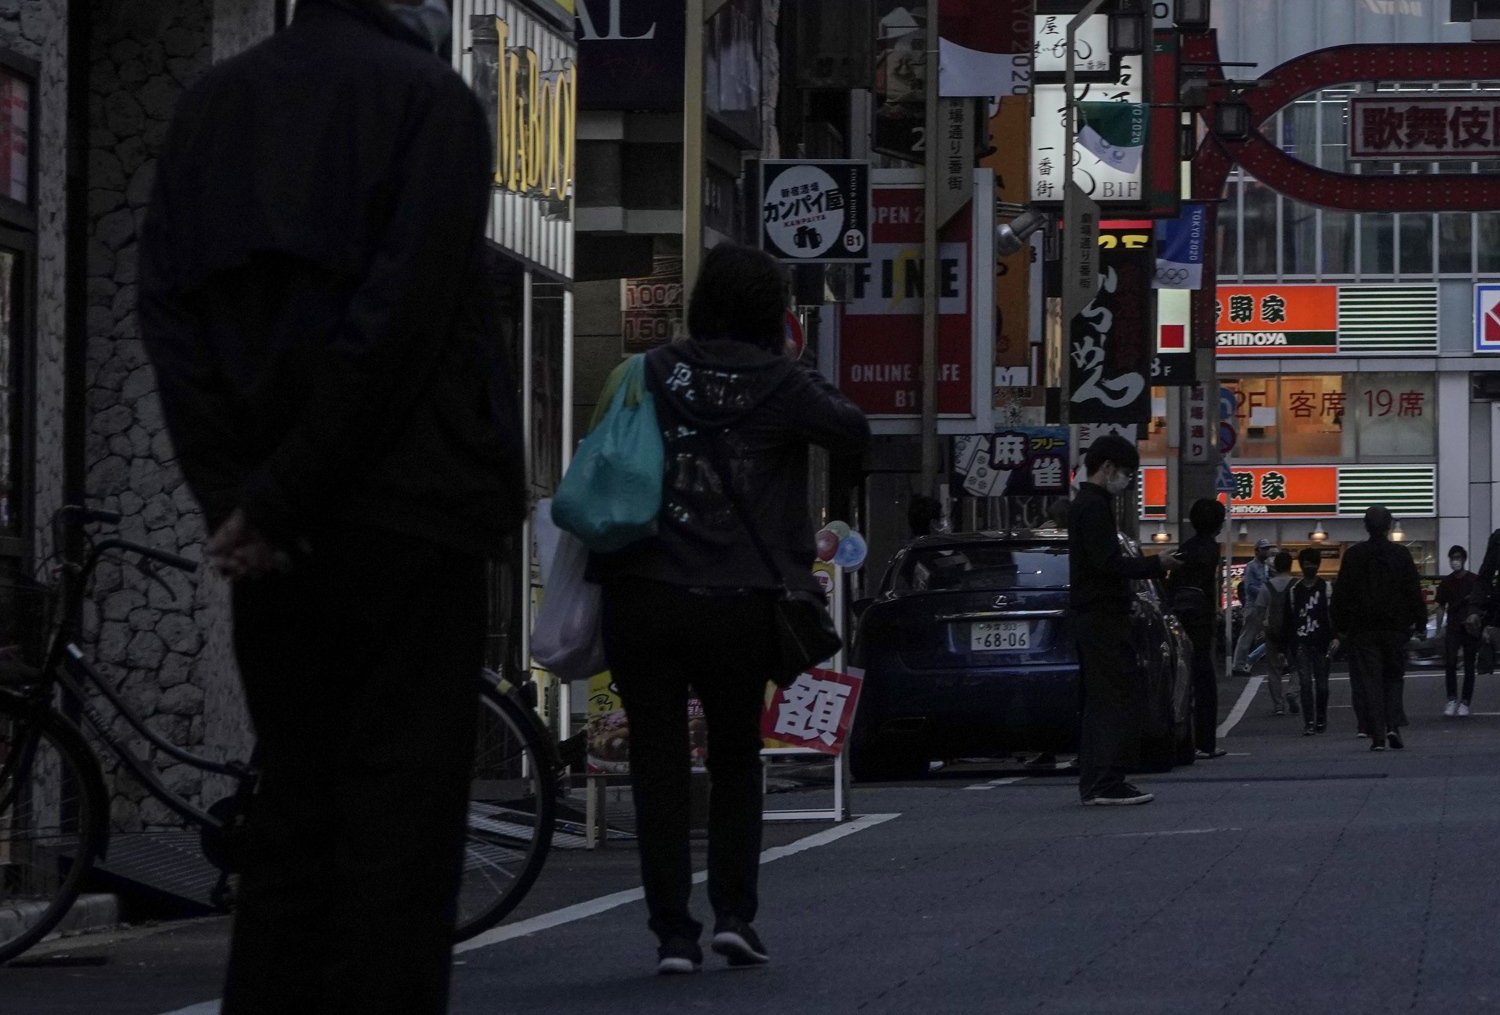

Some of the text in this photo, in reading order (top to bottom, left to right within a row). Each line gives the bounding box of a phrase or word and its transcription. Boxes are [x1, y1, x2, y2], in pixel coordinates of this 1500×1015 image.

[763, 187, 845, 224] カンパイ屋
[845, 234, 862, 247] B1
[1188, 240, 1201, 262] 2020
[850, 363, 913, 382] ONLINE
[894, 389, 916, 408] B1
[1288, 390, 1347, 418] 客席
[1364, 389, 1425, 418] 19席
[1031, 438, 1066, 451] フリー
[984, 632, 1026, 648] 68-06
[775, 673, 851, 747] 額
